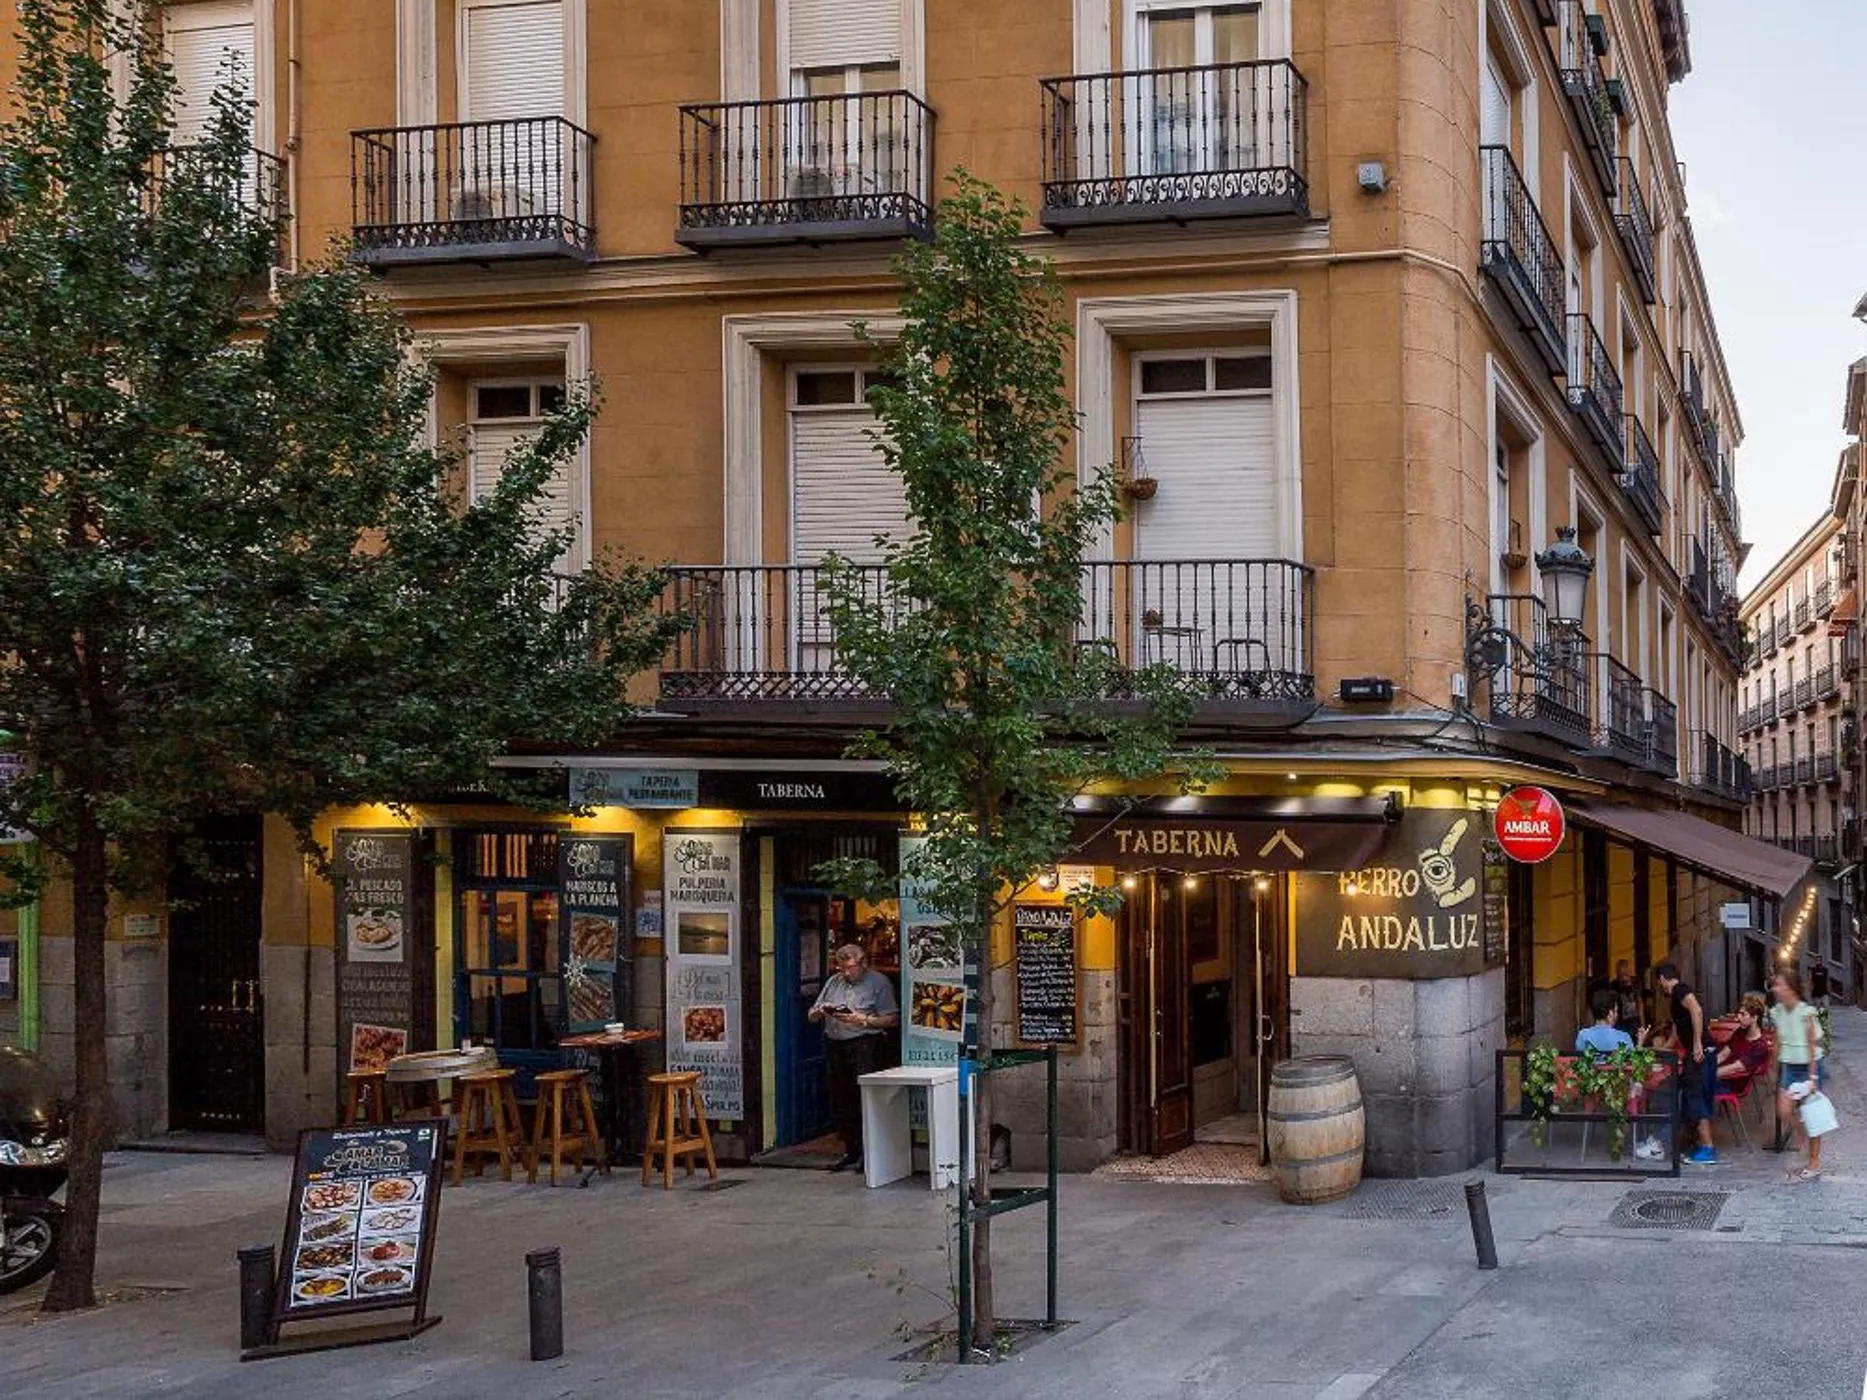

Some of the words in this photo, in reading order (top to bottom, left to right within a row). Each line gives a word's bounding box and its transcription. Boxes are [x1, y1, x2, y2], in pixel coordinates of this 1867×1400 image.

[757, 783, 826, 798] TABERNA
[1504, 821, 1551, 834] AMBAR
[1115, 829, 1240, 858] TABERNA
[1338, 867, 1421, 898] PERRO
[1336, 914, 1480, 951] ANDALUZ
